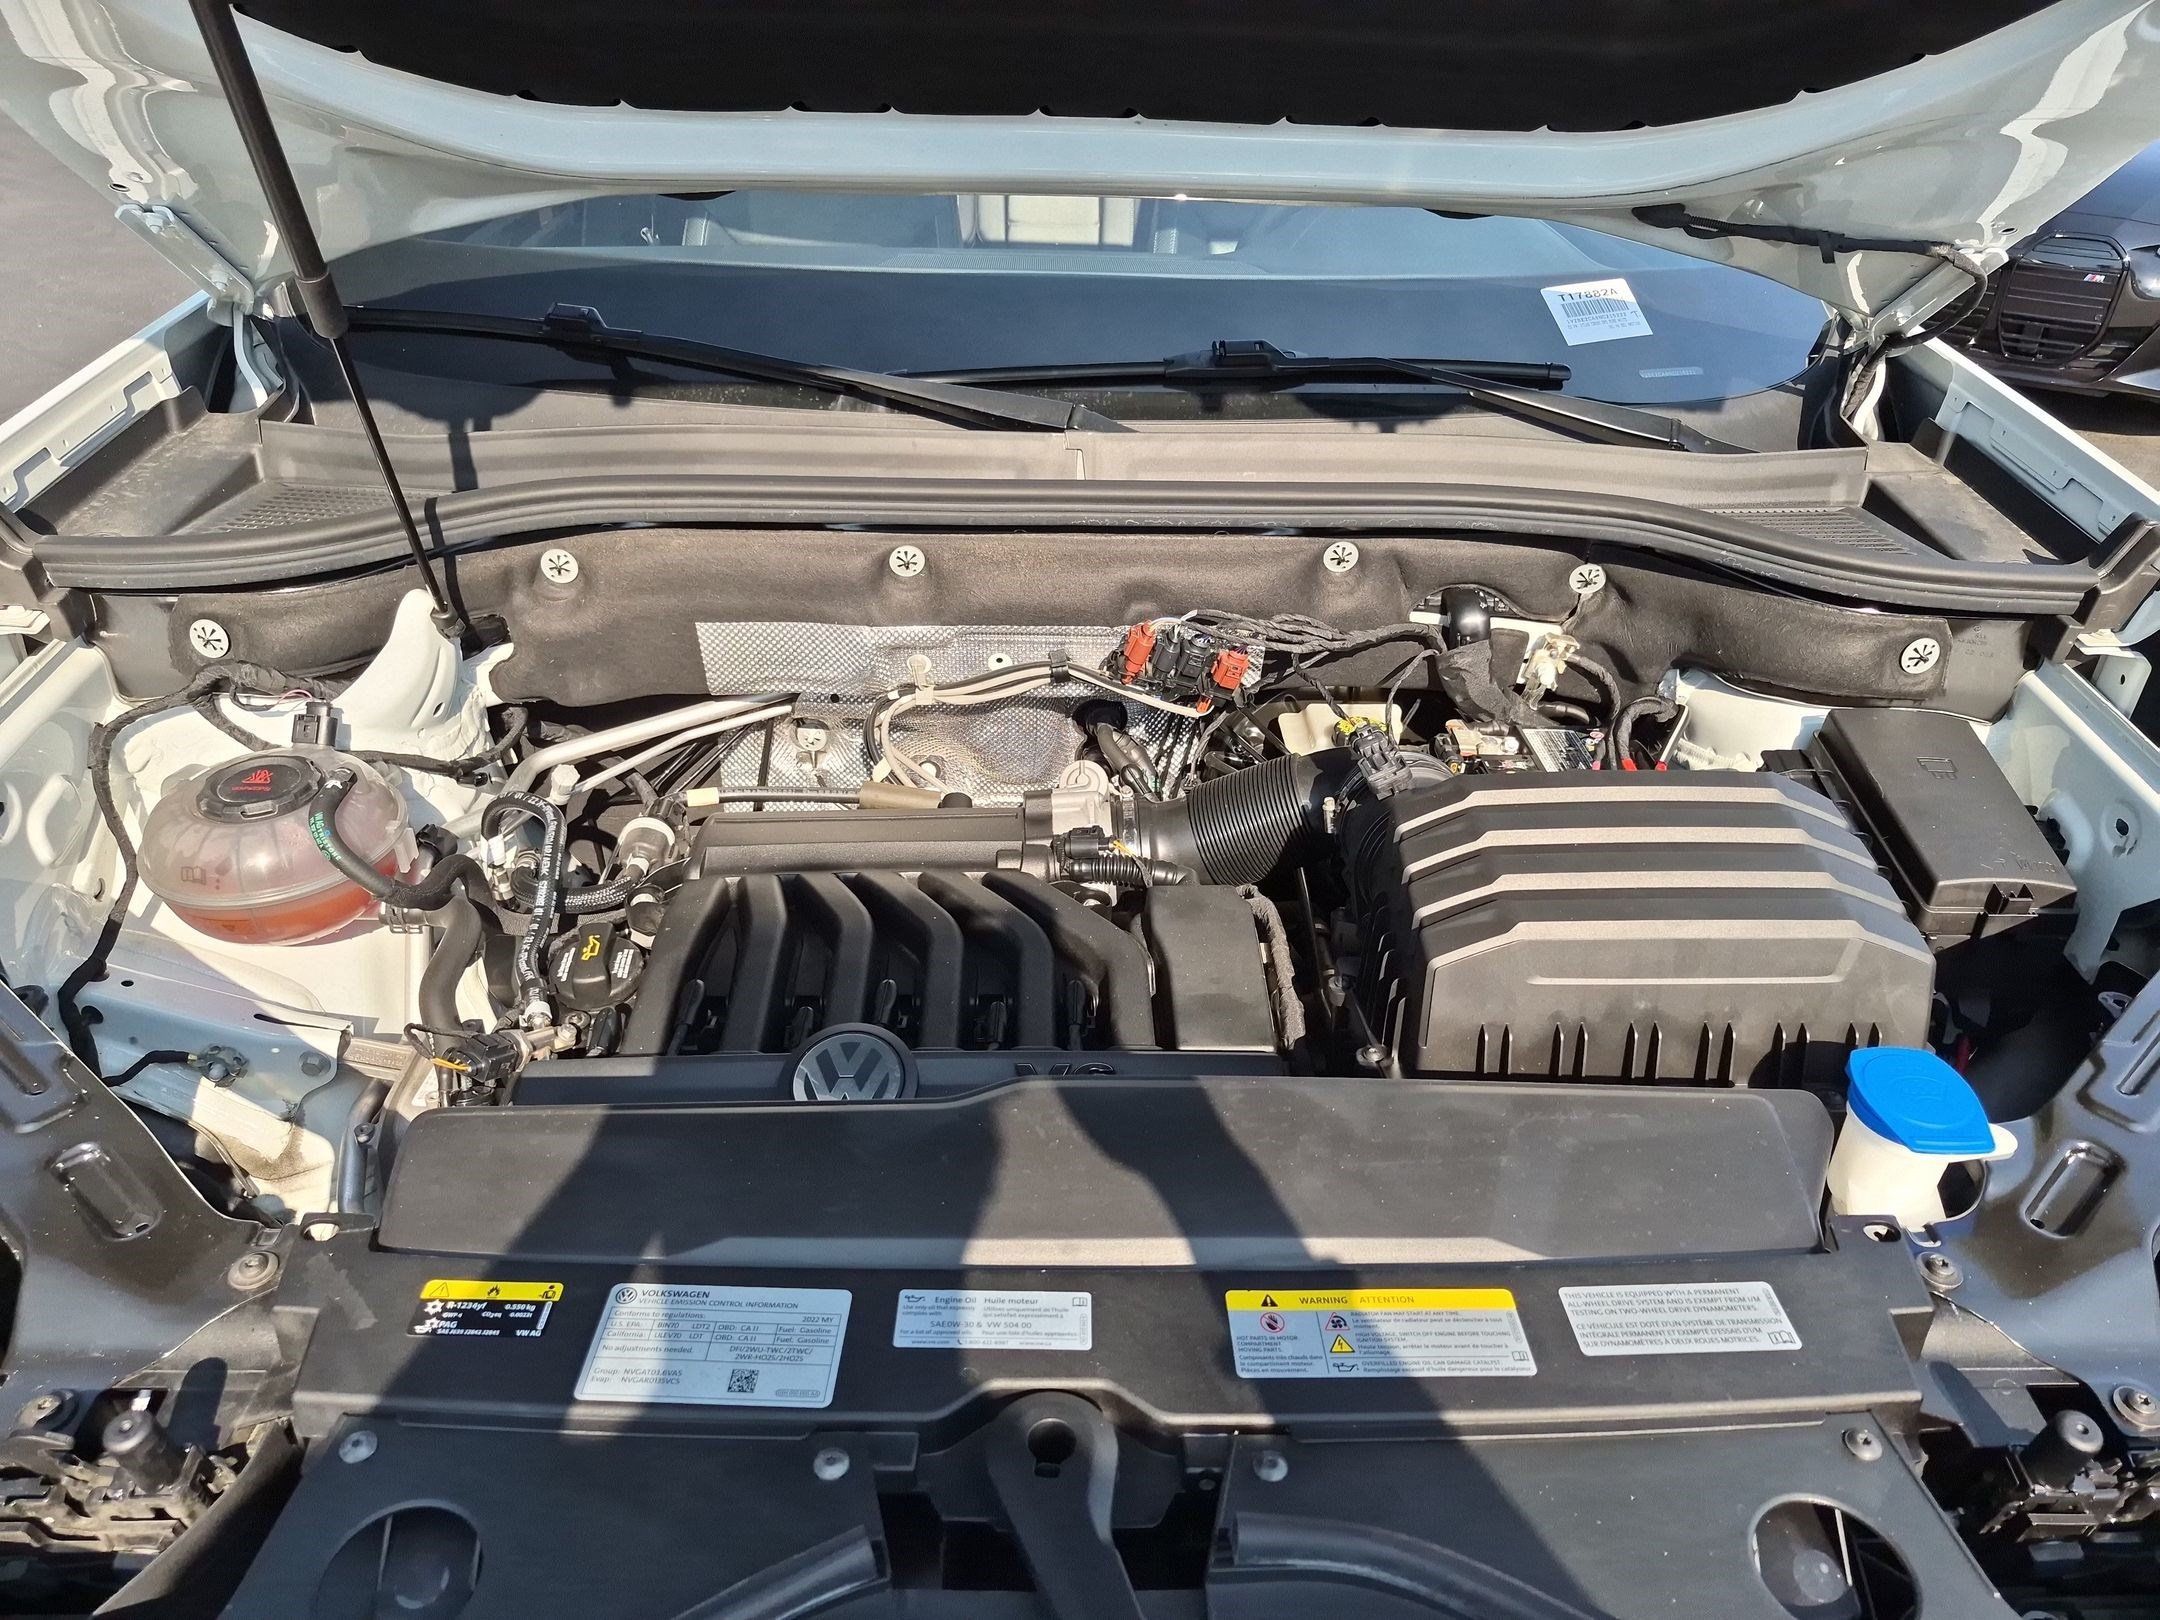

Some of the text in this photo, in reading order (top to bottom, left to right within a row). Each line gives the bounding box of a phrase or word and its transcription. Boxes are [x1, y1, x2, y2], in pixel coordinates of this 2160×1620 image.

[1558, 288, 1618, 302] T17882A
[641, 1289, 710, 1298] VOLKSWAGEN
[1625, 1290, 1663, 1298] EQUIPPED
[1664, 1289, 1686, 1297] WITH
[1693, 1287, 1740, 1296] PERMANENT
[934, 1296, 976, 1304] Engine Oil
[1299, 1296, 1415, 1304] WARNING ATTENTION
[1568, 1300, 1611, 1308] ALL-WHEEL
[446, 1301, 488, 1311] R-1234yf
[745, 1301, 798, 1309] INFORMATION
[1571, 1308, 1603, 1316] TESTING
[1619, 1307, 1666, 1315] TWO-WHEEL
[1668, 1305, 1693, 1313] DRIVE
[438, 1320, 458, 1328] PAG
[1661, 1319, 1681, 1327] D'UN
[1728, 1317, 1783, 1326] TRANSMISSION
[1620, 1329, 1665, 1337] PERMANENT
[1667, 1328, 1676, 1336] ET
[1583, 1340, 1598, 1348] SUR
[1671, 1337, 1692, 1345] DEUX
[1694, 1336, 1720, 1344] ROUES
[614, 1344, 662, 1353] adjustments
